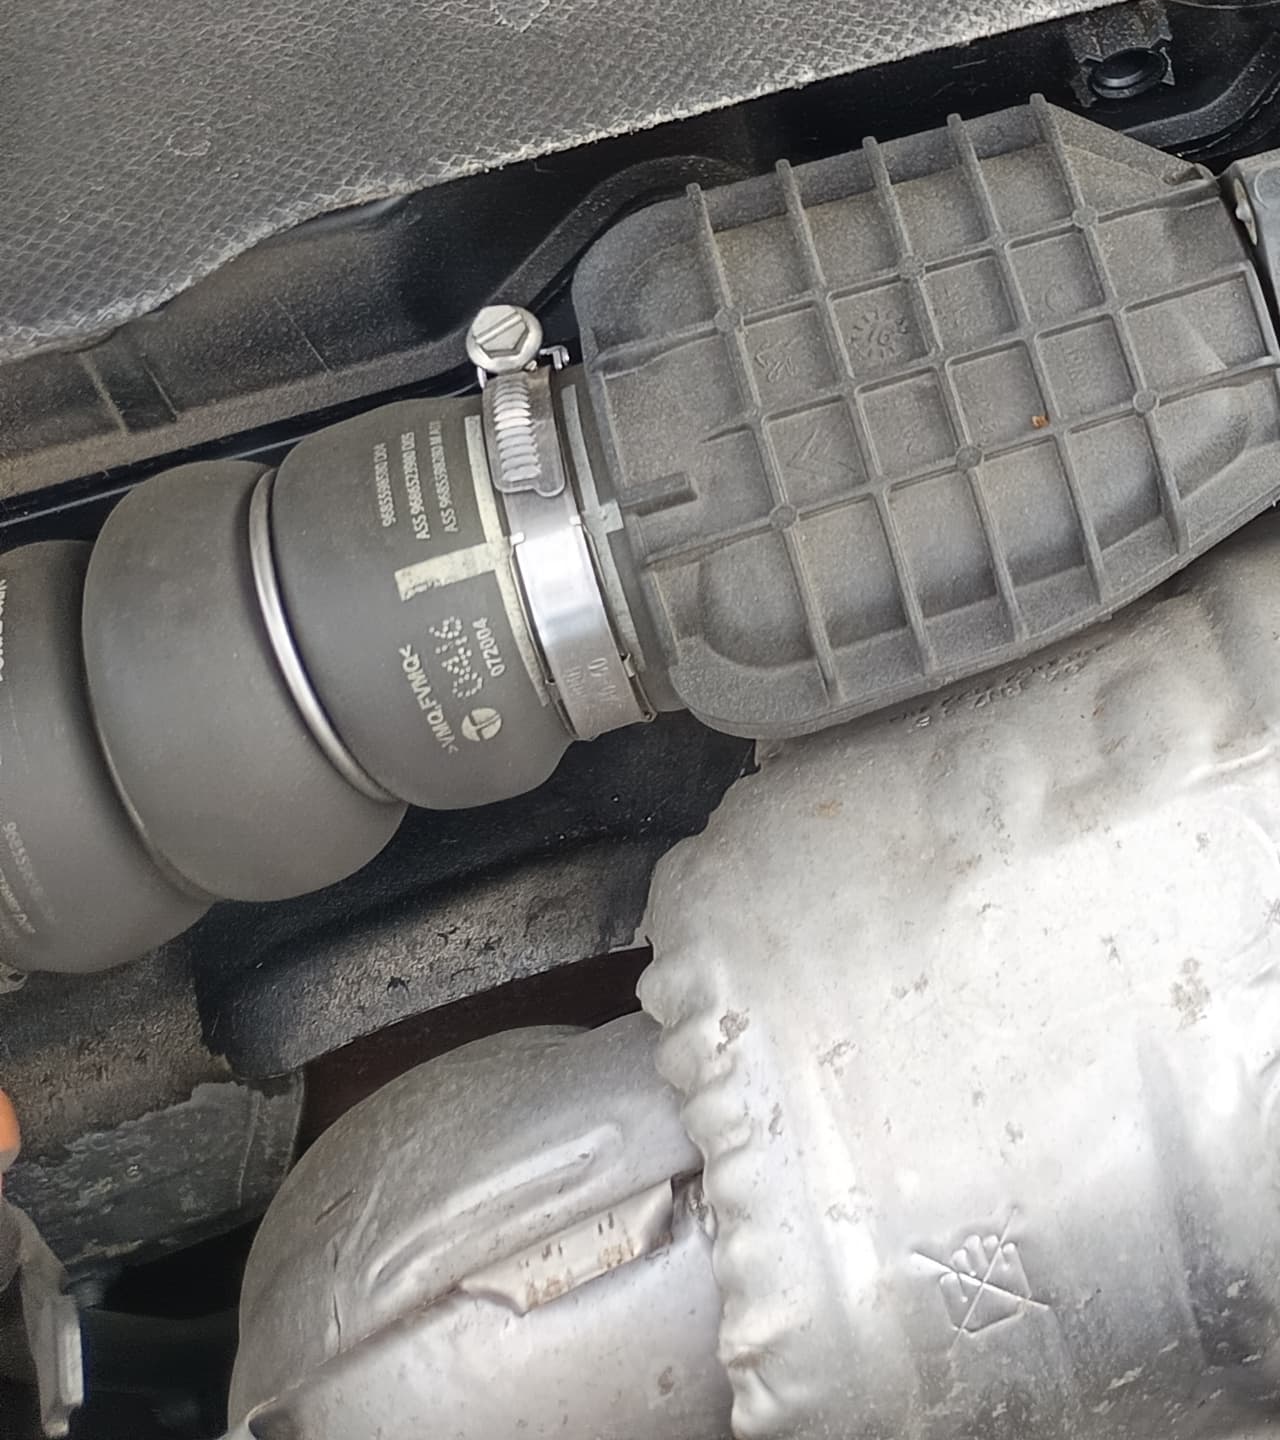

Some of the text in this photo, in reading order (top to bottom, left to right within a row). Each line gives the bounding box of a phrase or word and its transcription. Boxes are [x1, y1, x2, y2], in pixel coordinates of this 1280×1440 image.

[412, 514, 430, 539] ASS
[440, 508, 458, 532] ASS
[472, 617, 506, 678] 072004
